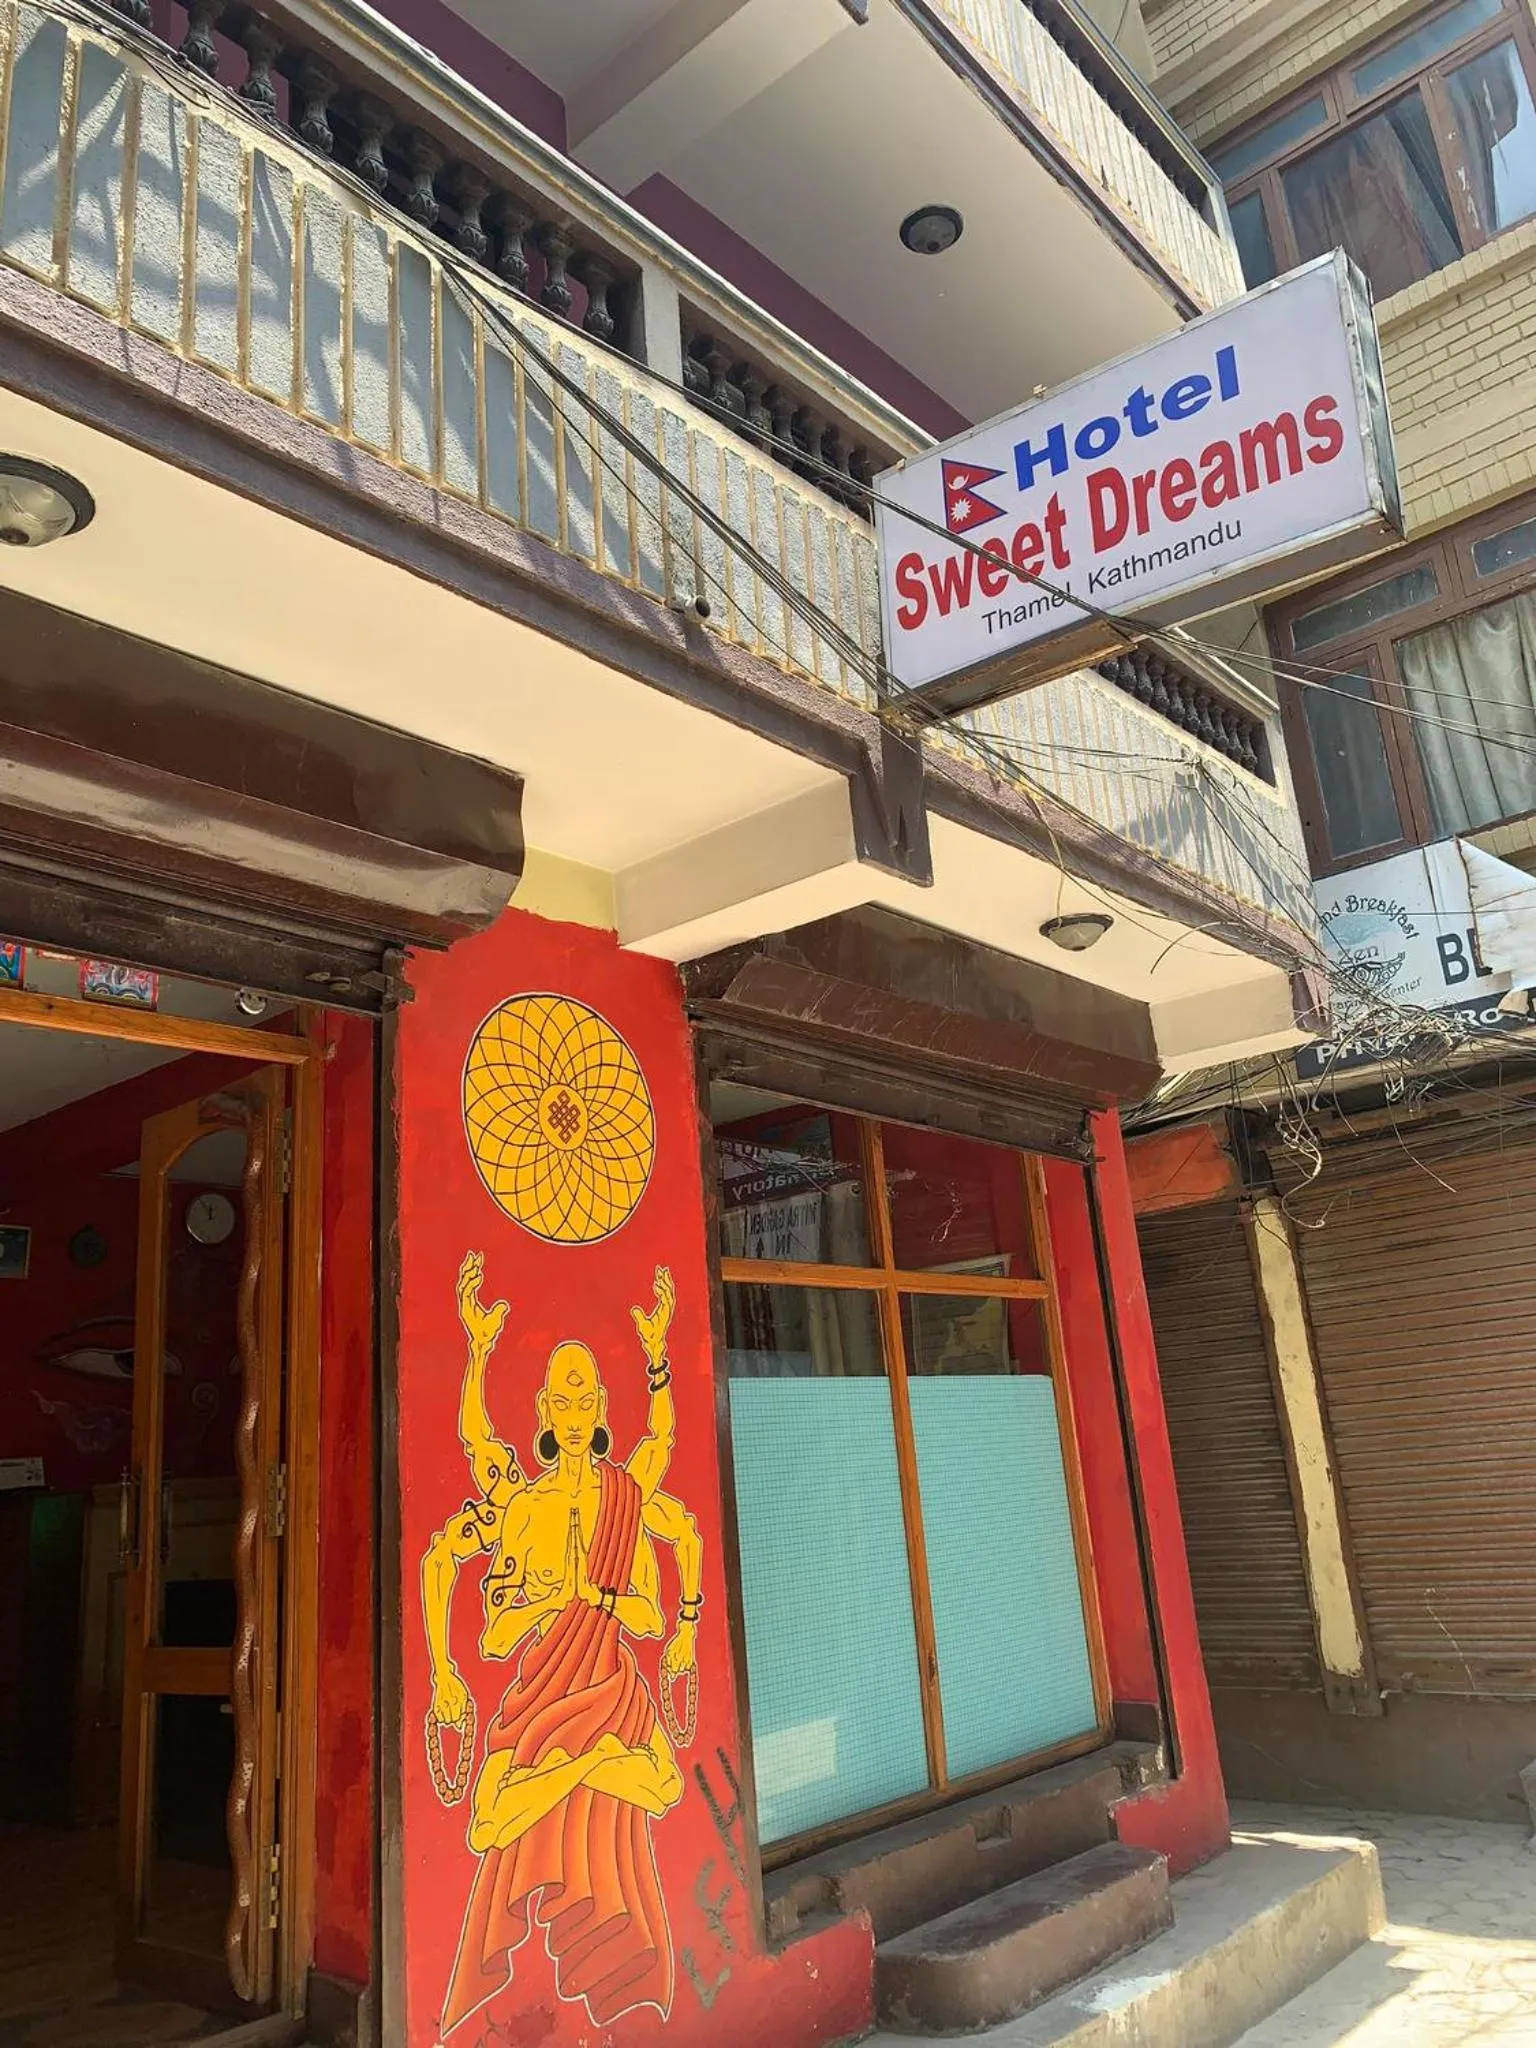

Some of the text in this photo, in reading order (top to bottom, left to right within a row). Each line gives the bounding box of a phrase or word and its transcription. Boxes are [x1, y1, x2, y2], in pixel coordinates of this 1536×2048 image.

[1013, 345, 1240, 492] Hotel
[896, 395, 1344, 632] Sweet Dreams
[981, 518, 1242, 635] Thamel Kathmandu
[1345, 894, 1420, 940] Breakfast
